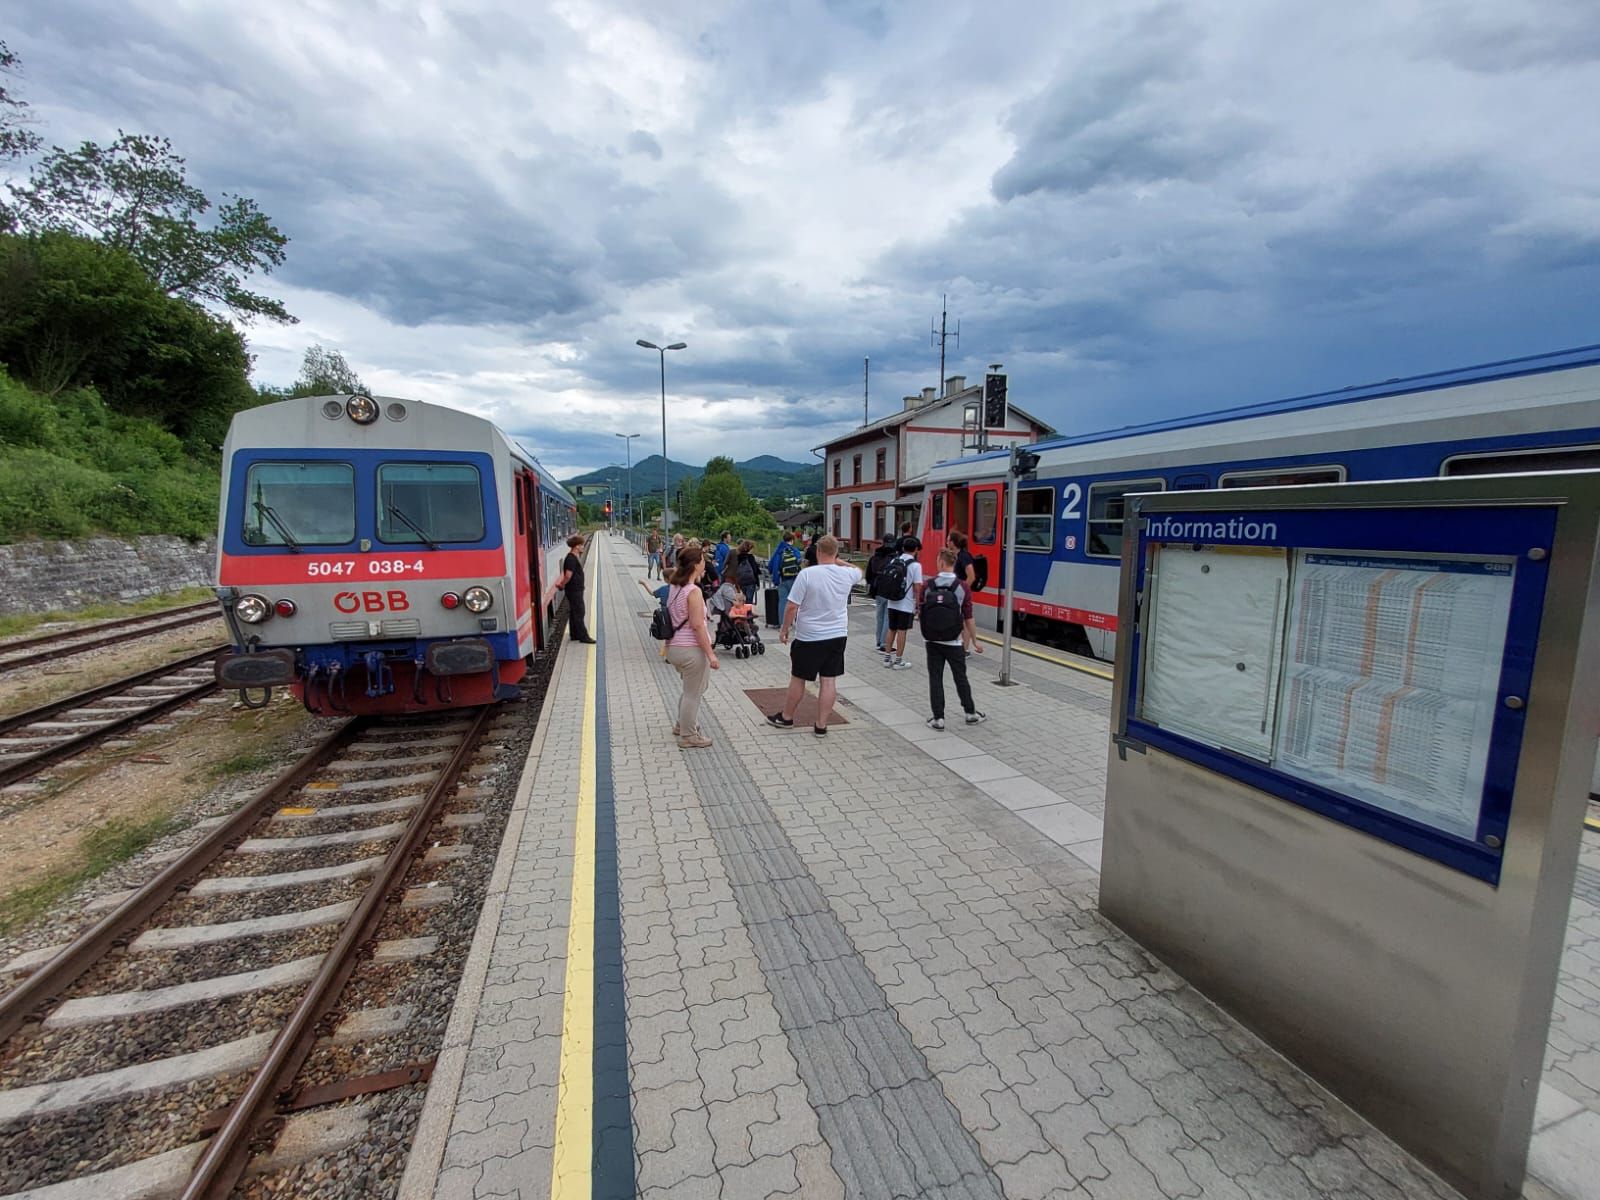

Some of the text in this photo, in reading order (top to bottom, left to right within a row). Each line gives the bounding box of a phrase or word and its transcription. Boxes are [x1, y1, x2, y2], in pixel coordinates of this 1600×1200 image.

[1061, 483, 1082, 520] 2
[1145, 516, 1277, 540] Information
[307, 560, 424, 576] 5047 038-4
[334, 590, 410, 614] ÖBB
